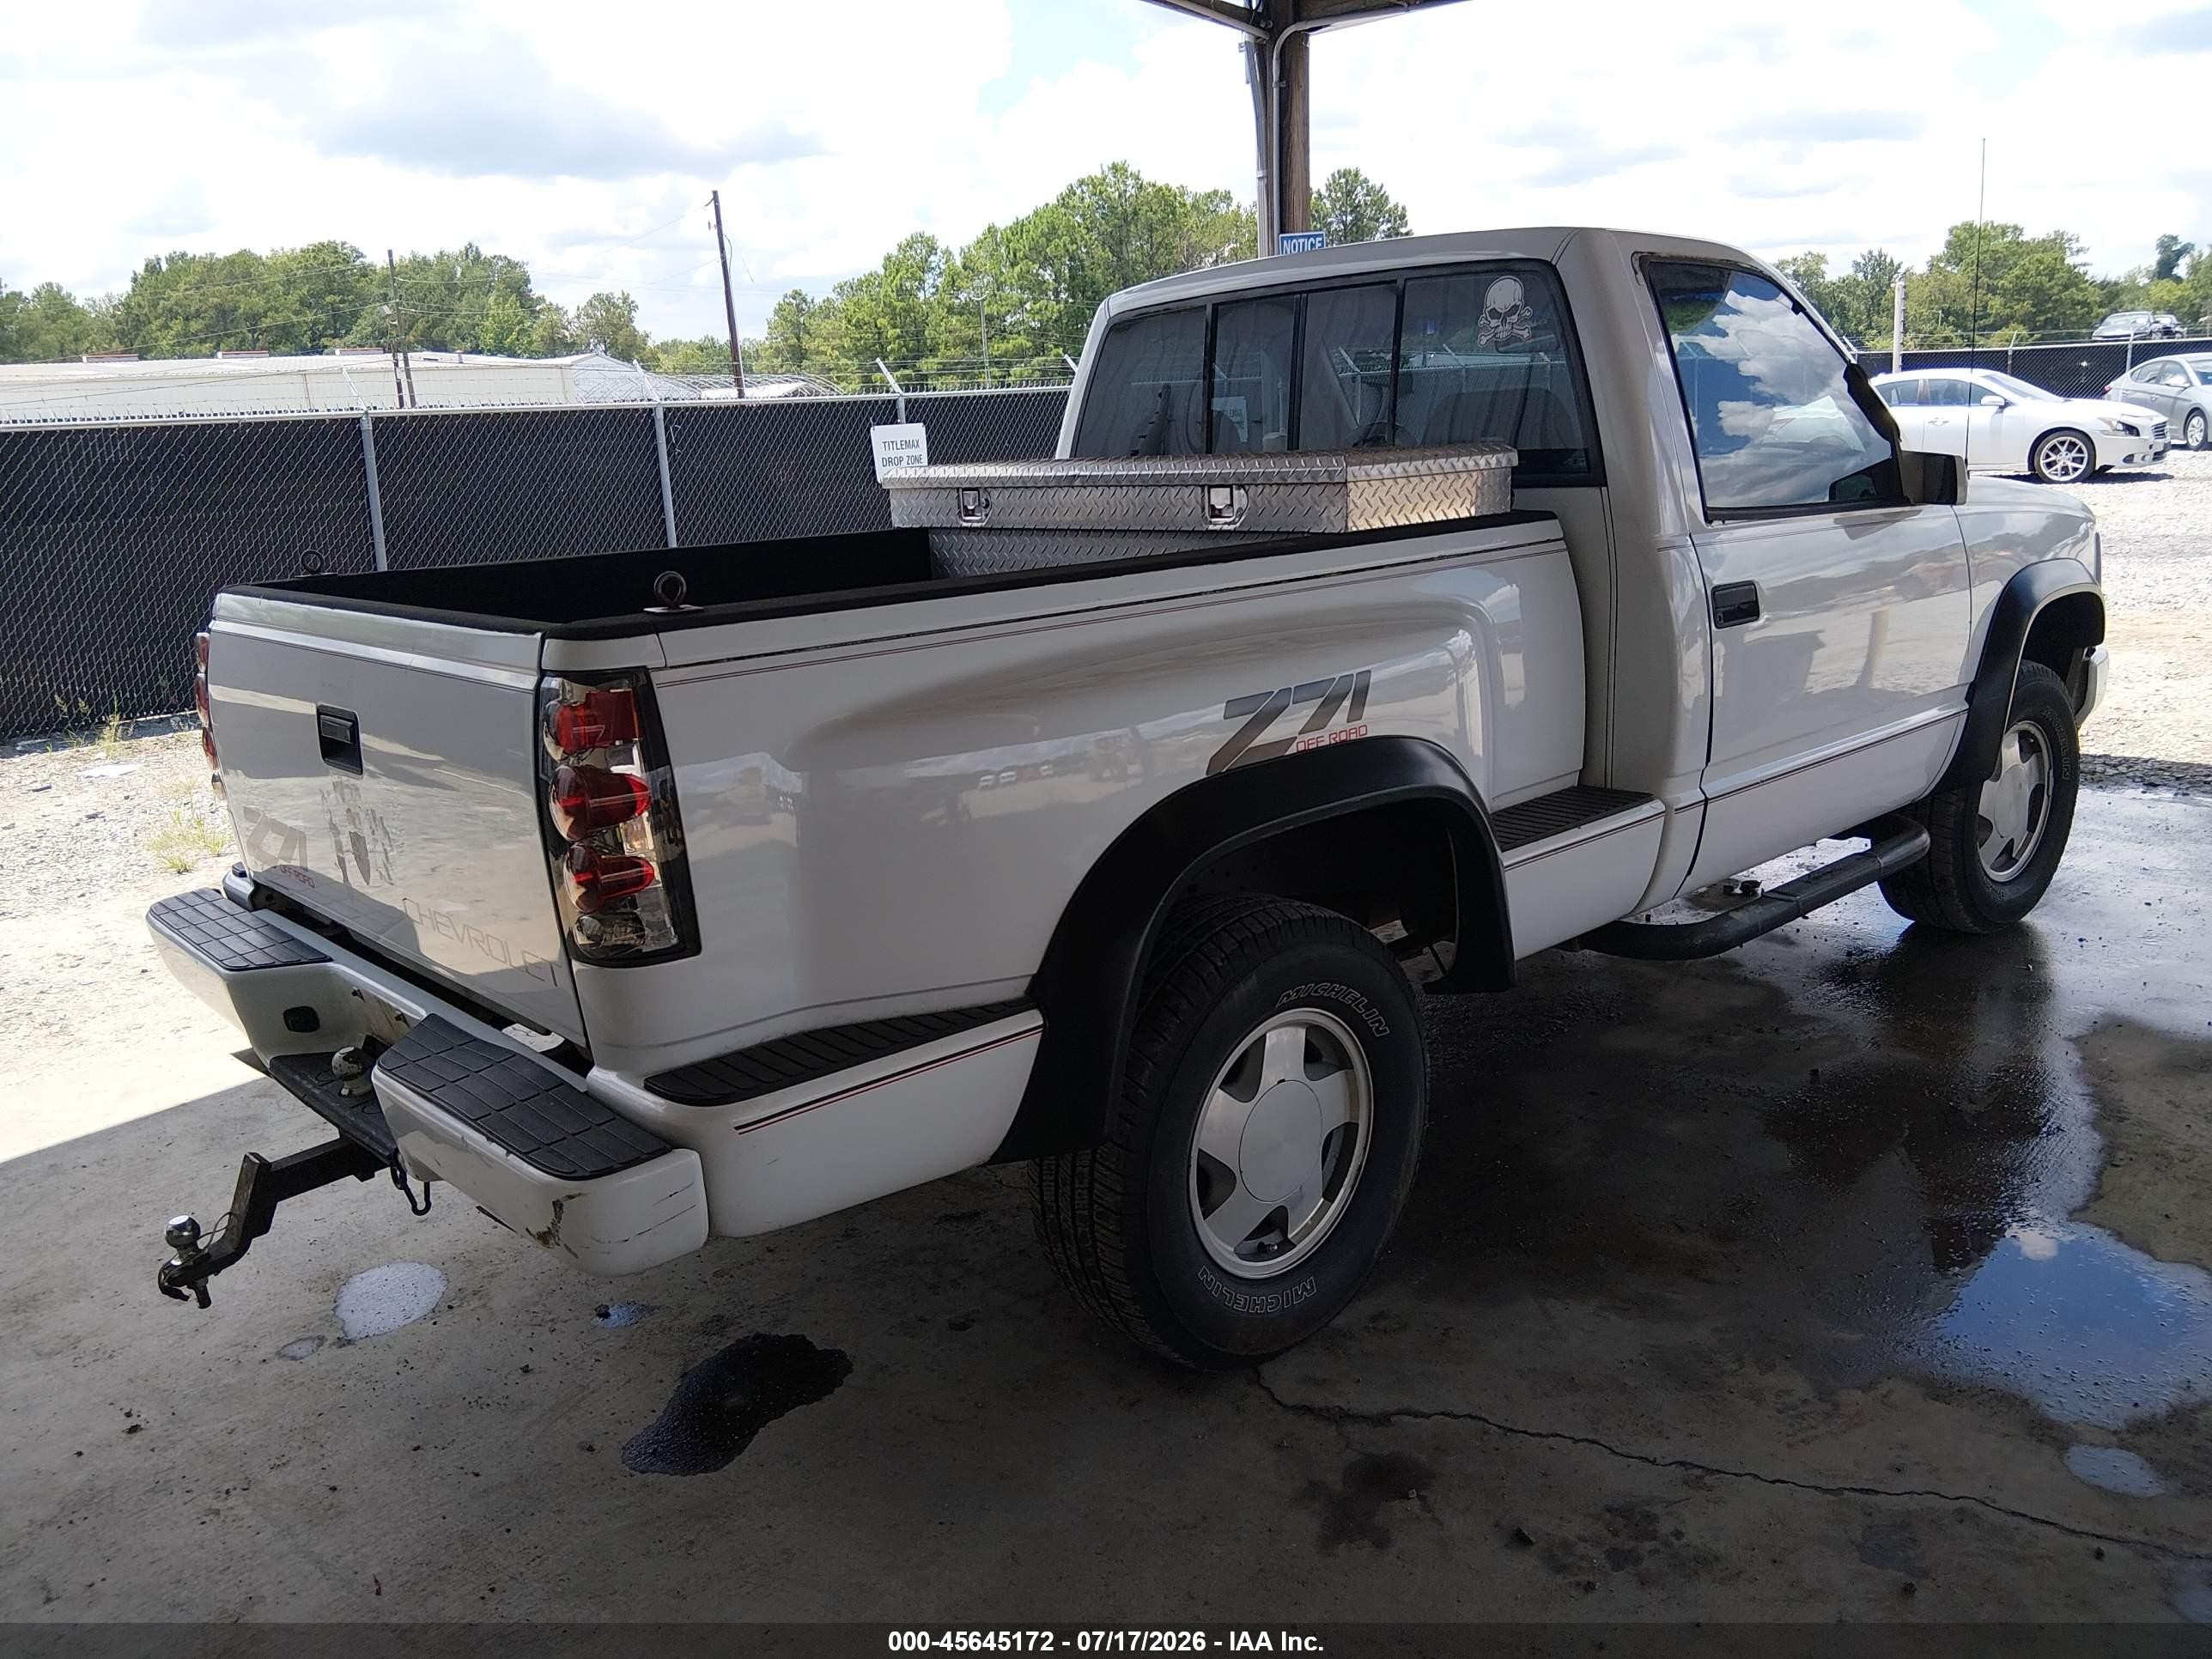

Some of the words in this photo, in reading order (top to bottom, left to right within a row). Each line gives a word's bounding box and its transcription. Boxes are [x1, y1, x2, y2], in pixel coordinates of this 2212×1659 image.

[1283, 237, 1322, 255] NOTICE
[881, 456, 903, 467] DROP
[906, 454, 923, 465] ZONE
[882, 439, 920, 451] TITLEMAX
[1206, 670, 1371, 776] Z71
[1296, 737, 1325, 752] OFF
[1328, 725, 1367, 744] ROAD
[402, 897, 562, 988] CHEVROLET
[1275, 981, 1390, 1037] MICHELIN
[1197, 1265, 1317, 1313] MICHELIN
